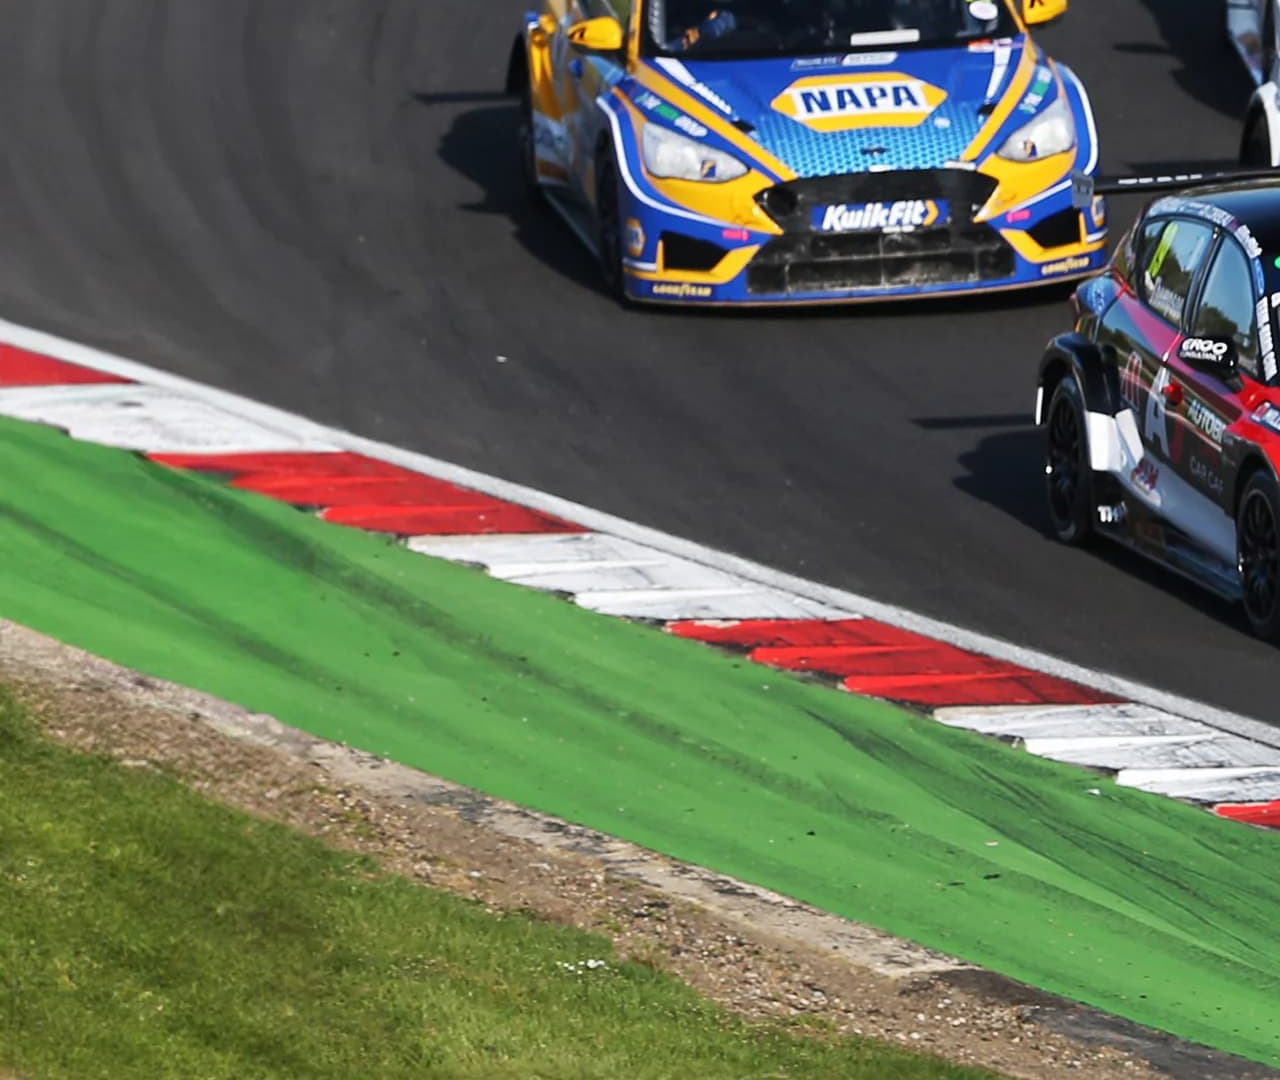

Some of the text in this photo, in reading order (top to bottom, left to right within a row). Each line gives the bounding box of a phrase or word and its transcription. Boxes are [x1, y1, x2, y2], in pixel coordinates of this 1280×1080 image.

[799, 85, 919, 113] NAPA
[822, 200, 926, 231] KwikFit
[1181, 337, 1228, 354] ERGO
